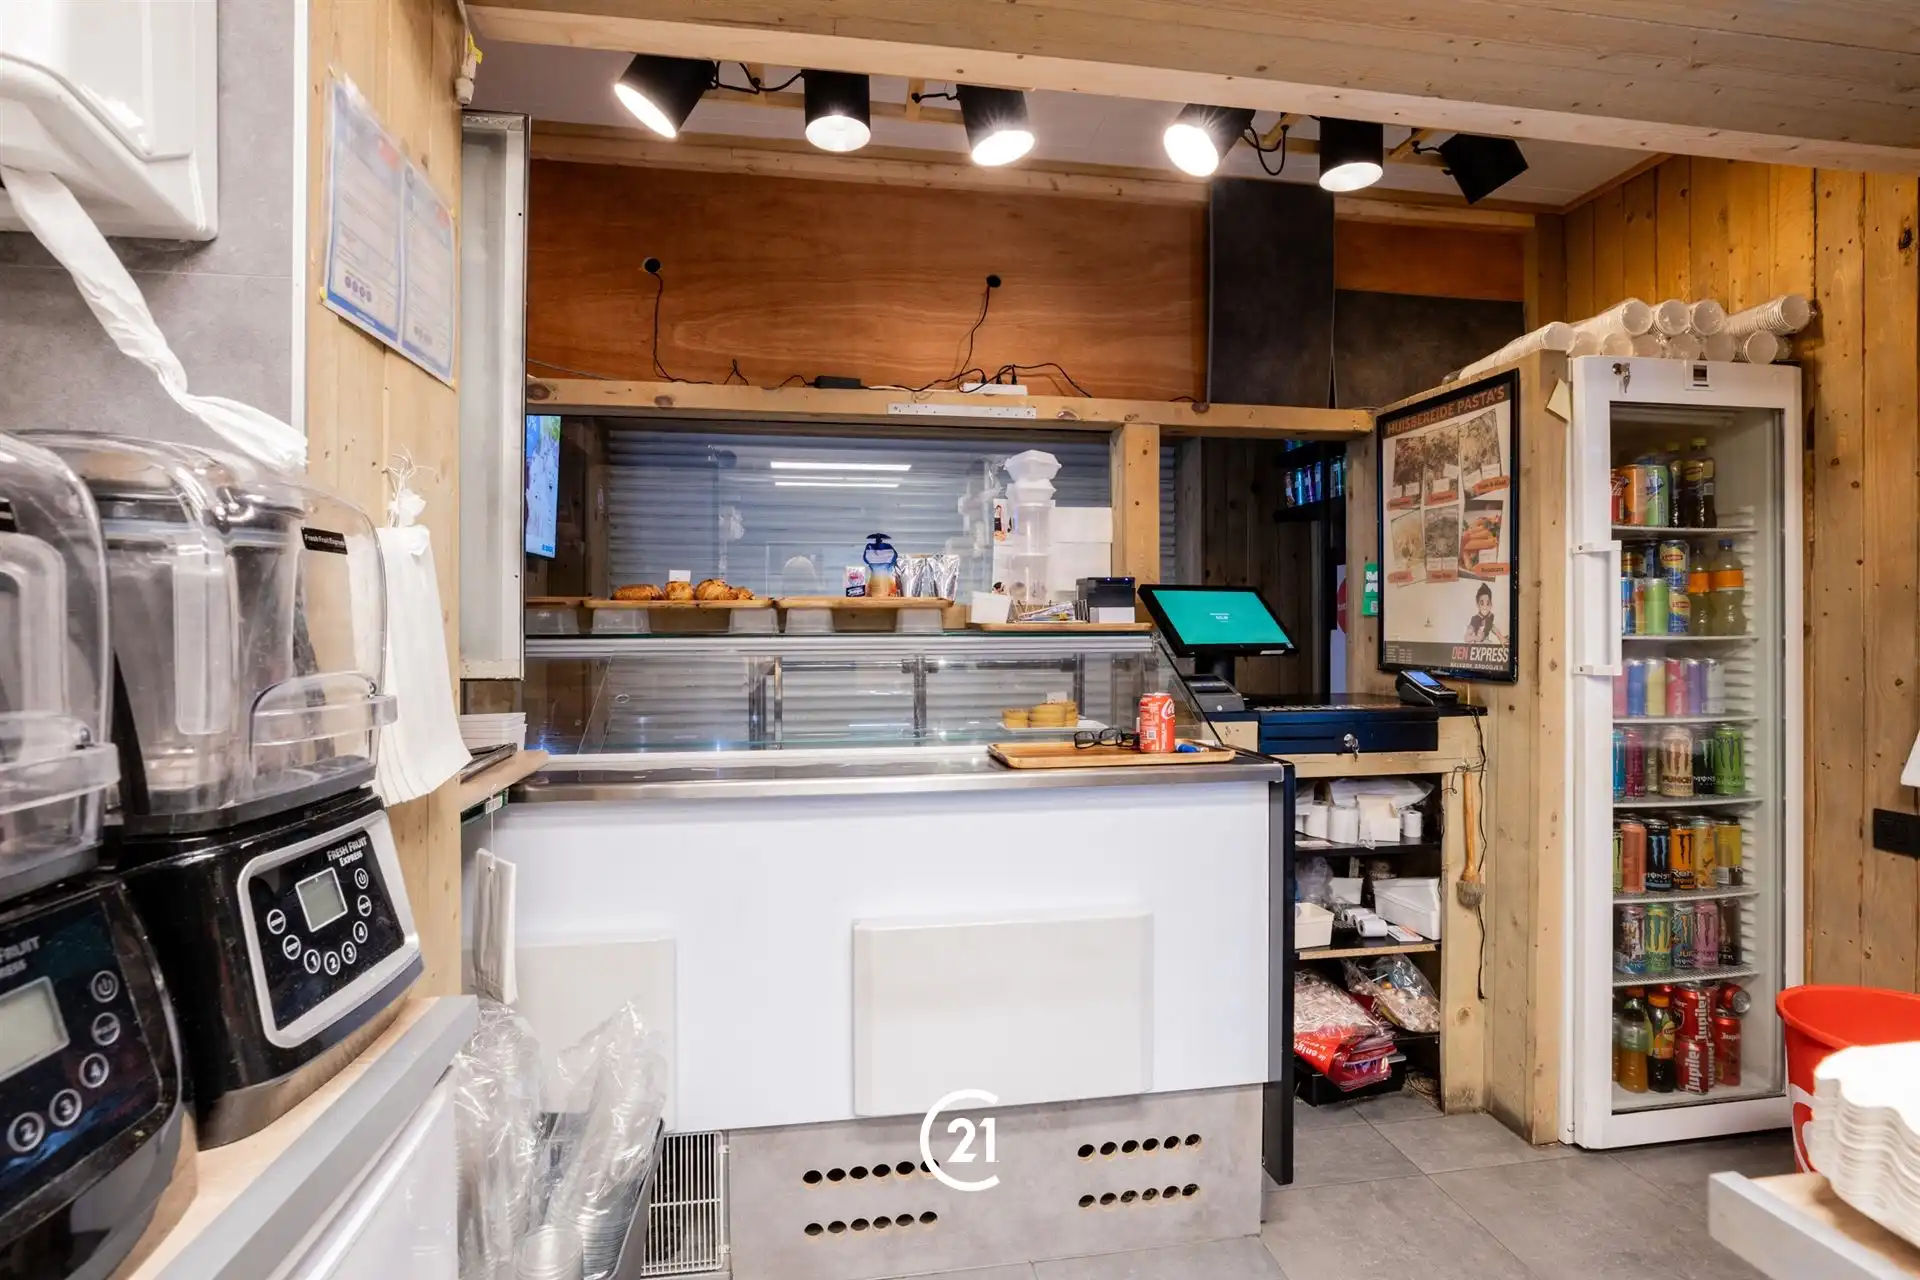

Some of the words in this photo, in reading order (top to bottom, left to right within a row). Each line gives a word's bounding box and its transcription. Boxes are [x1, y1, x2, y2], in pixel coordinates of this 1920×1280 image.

[1387, 403, 1454, 435] HUISBEREIDE
[1458, 386, 1505, 413] PASTA'S
[1469, 646, 1510, 662] EXPRESS
[326, 844, 349, 861] FRESH
[347, 837, 368, 853] FRUIT
[339, 850, 364, 867] EXPRESS
[358, 926, 364, 937] 4
[311, 955, 317, 967] 1
[347, 946, 353, 958] 3
[329, 957, 337, 969] 2
[1695, 992, 1709, 1043] Jupiler
[1685, 1041, 1703, 1093] Jupiler
[61, 1098, 74, 1117] 3
[19, 1121, 37, 1142] 2
